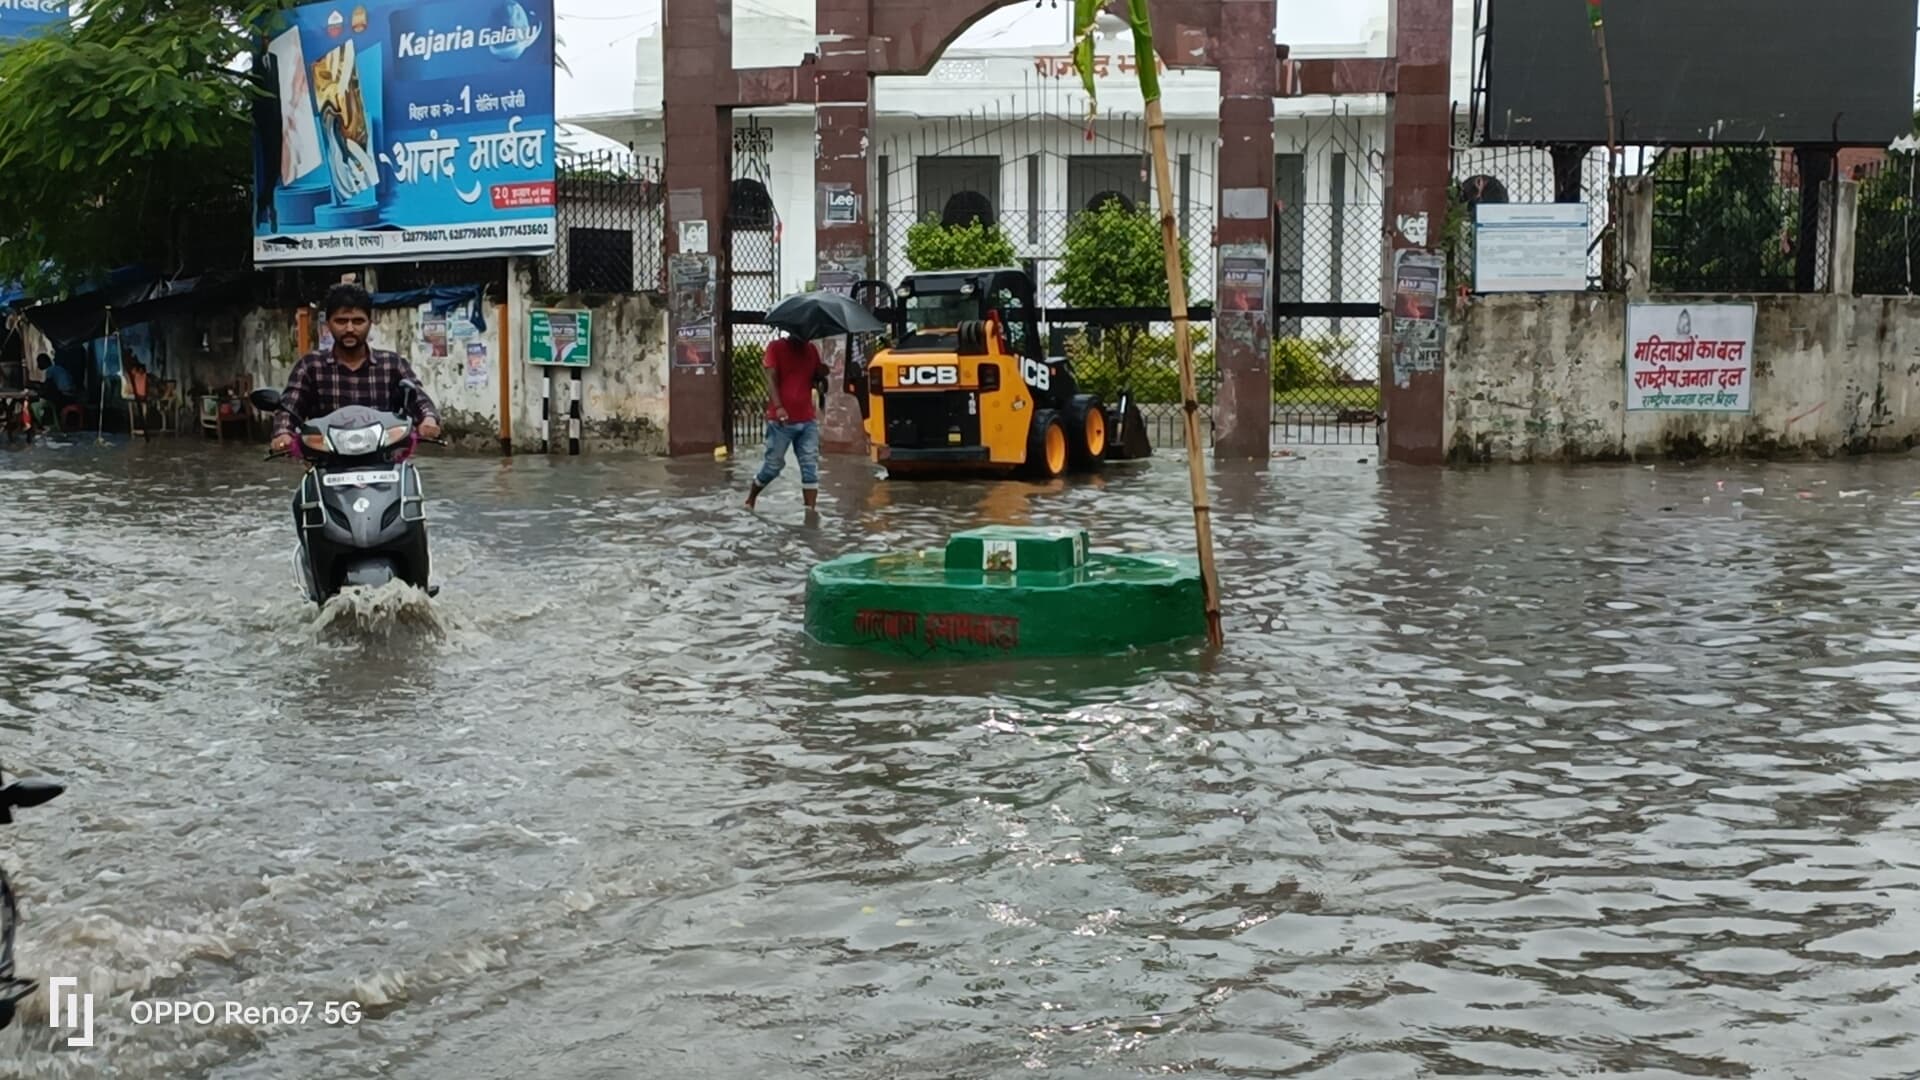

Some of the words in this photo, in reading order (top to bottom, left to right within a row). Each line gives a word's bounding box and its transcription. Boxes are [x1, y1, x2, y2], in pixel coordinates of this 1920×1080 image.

[398, 25, 474, 60] Kajaria
[478, 25, 540, 48] Galaxy
[408, 103, 428, 120] बिहार
[430, 104, 441, 118] का
[380, 129, 478, 200] आनंद
[468, 115, 547, 171] मार्बल
[493, 187, 509, 200] 20
[830, 192, 854, 206] Lee
[1635, 334, 1698, 366] महिलाओं
[1697, 340, 1718, 359] का
[1717, 340, 1746, 361] बल
[900, 366, 958, 385] JCB
[1635, 365, 1681, 390] राष्ट्रीय
[1679, 368, 1718, 388] जनता
[1718, 368, 1746, 389] दल
